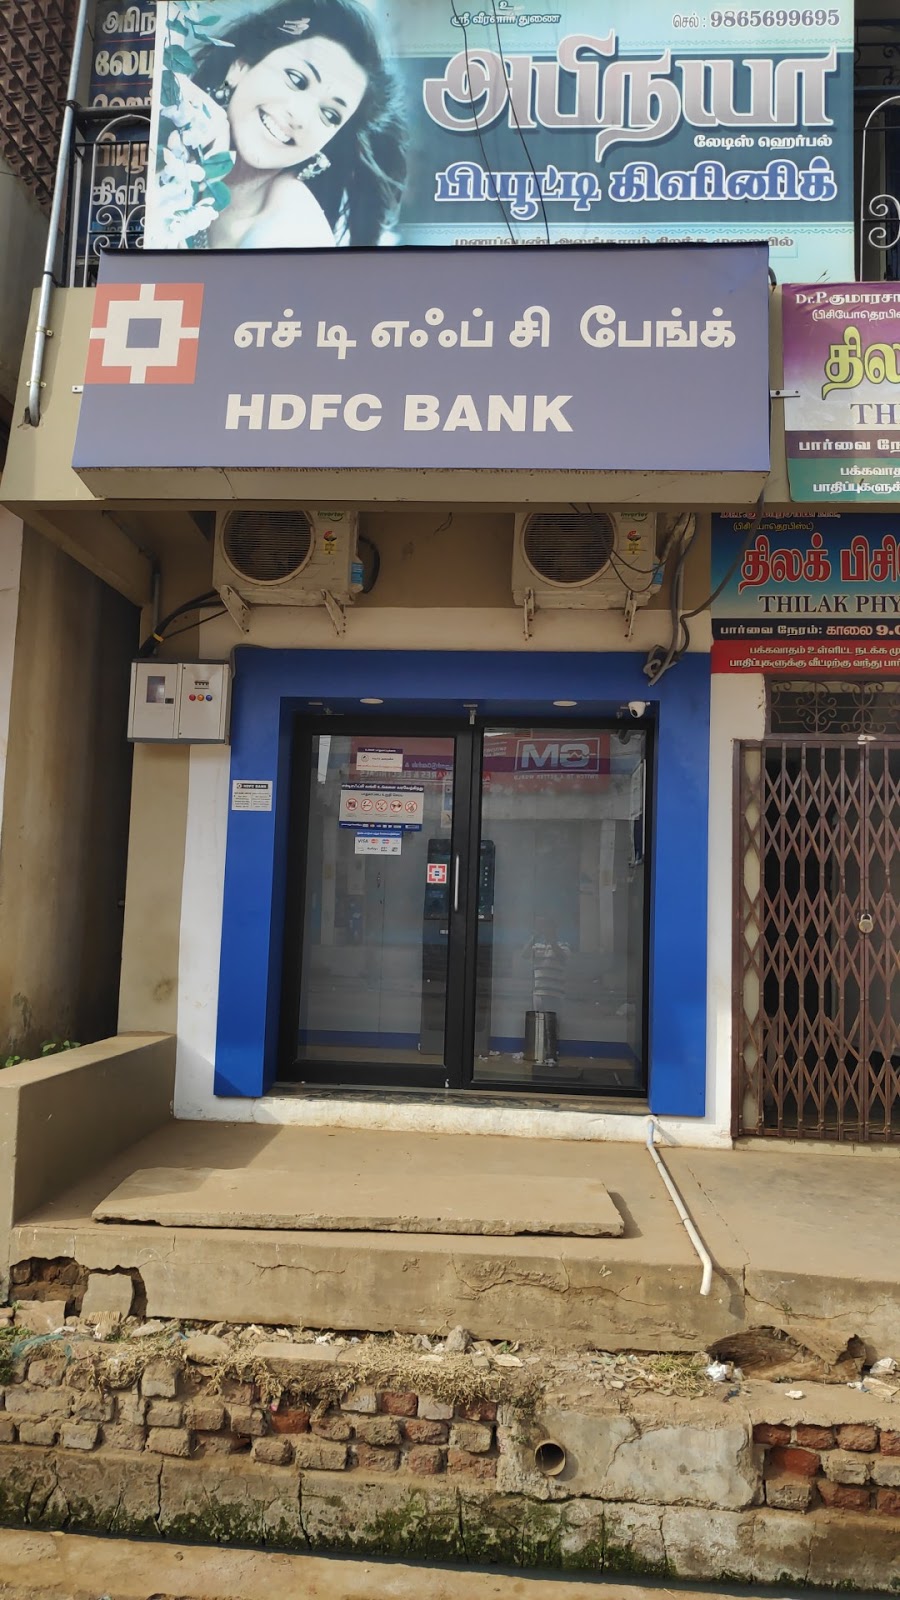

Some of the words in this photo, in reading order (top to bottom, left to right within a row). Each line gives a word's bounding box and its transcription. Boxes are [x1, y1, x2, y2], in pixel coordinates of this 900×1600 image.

[710, 9, 840, 28] 9865699695
[422, 28, 838, 162] அபிநயா
[693, 134, 754, 150] லேடிஸ்
[758, 134, 833, 150] ஹெர்பல்
[435, 161, 601, 220] பியூட்டி
[608, 156, 838, 201] கிளினிக்
[233, 308, 302, 349] எச்
[317, 319, 356, 360] டி
[509, 304, 549, 349] சி
[579, 304, 736, 349] பேங்க்
[224, 393, 383, 432] HDFC
[403, 394, 574, 433] BANK
[850, 403, 900, 425] TH
[799, 438, 871, 451] பார்வை
[738, 532, 831, 595] திலக்
[840, 534, 900, 582] பிசி
[758, 595, 849, 613] THILAK
[720, 625, 773, 635] பார்வை
[826, 625, 873, 636] காலை
[750, 645, 805, 655] பக்கவாதம்
[729, 657, 806, 669] பாதிப்புகளுக்கு
[853, 658, 882, 669] வந்து
